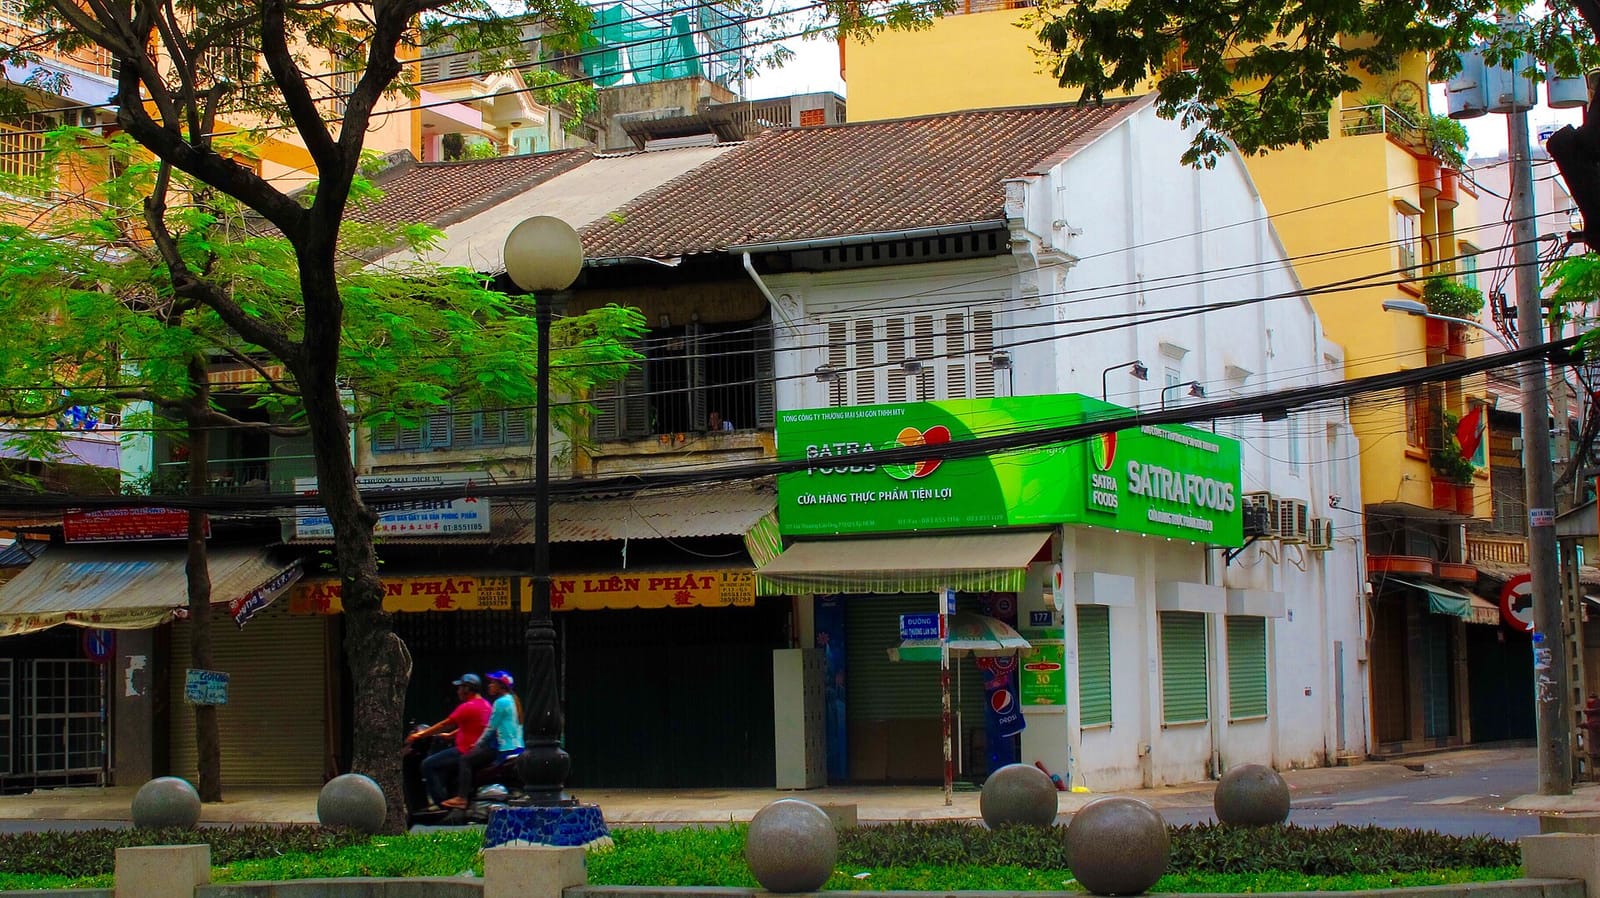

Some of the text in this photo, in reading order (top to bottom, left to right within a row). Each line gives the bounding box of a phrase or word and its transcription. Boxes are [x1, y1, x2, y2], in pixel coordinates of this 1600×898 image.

[814, 413, 821, 421] TY
[892, 407, 905, 416] MTV
[1092, 473, 1118, 492] SATRA
[1127, 459, 1236, 514] SATRAFOODS
[818, 491, 847, 505] HÀNG
[849, 490, 876, 505] THỰC
[878, 486, 909, 502] PHẨM
[910, 487, 933, 502] TIỆN
[934, 487, 952, 502] LỢI
[1093, 490, 1119, 509] FOODS
[1033, 612, 1049, 622] 177
[999, 714, 1018, 724] pepsi
